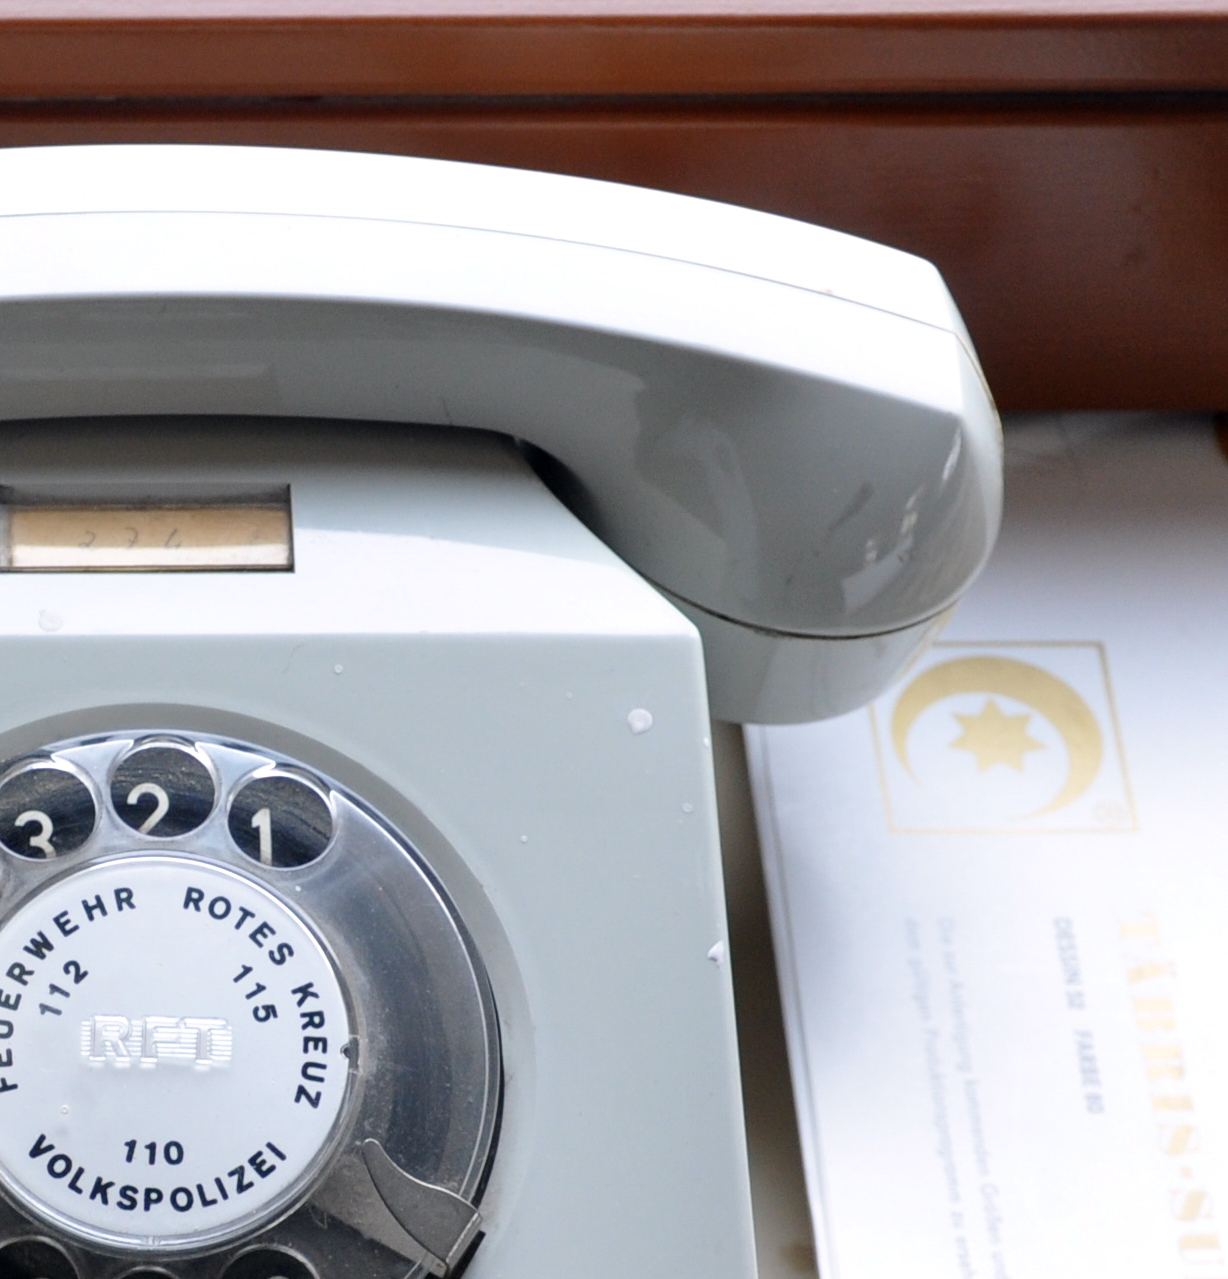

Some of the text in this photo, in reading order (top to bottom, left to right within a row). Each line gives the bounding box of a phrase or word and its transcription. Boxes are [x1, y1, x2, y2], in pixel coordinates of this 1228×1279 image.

[14, 811, 56, 858] 3
[127, 782, 170, 834] 2
[251, 808, 272, 863] 1
[39, 960, 89, 1016] 112
[183, 886, 328, 1109] ROTES KREUZ
[233, 964, 278, 1023] 115
[1053, 917, 1082, 985] DESSIN
[1073, 1029, 1102, 1087] FARBE
[89, 1012, 230, 1063] RFT
[28, 1133, 287, 1213] VOLKSPOLIZEI
[124, 1139, 184, 1166] 110
